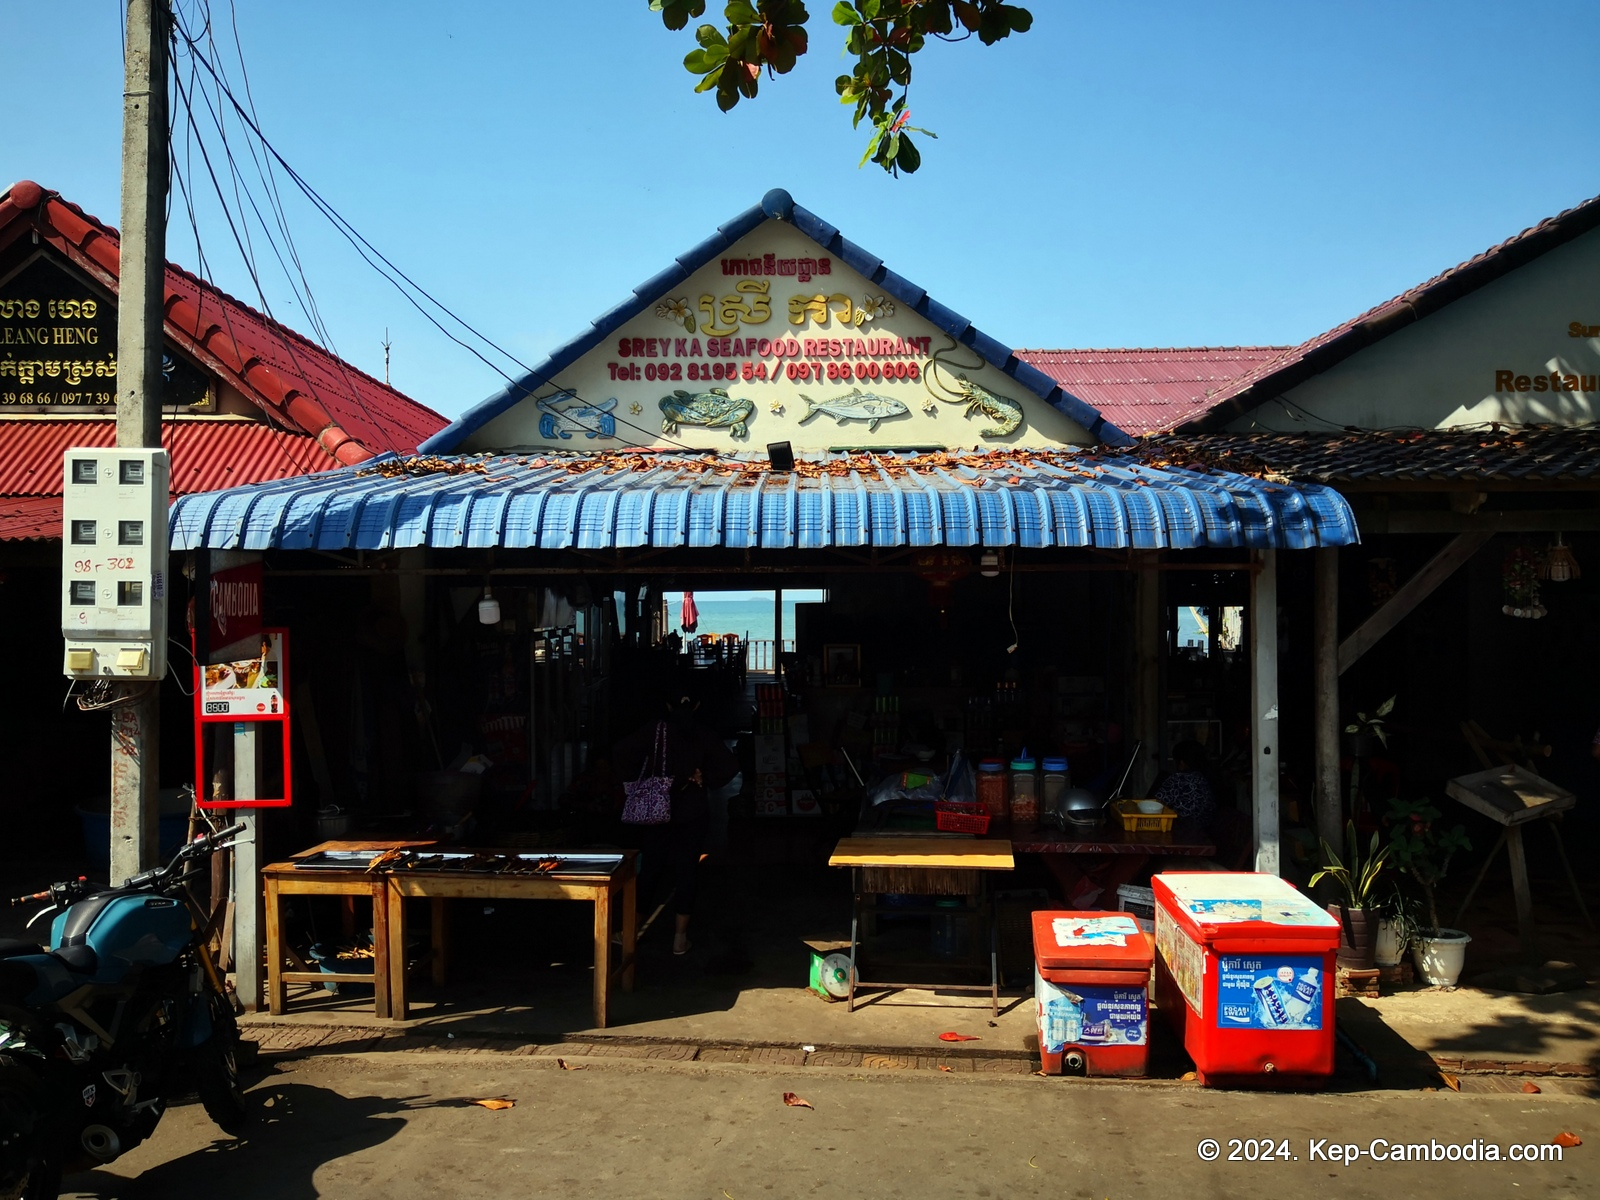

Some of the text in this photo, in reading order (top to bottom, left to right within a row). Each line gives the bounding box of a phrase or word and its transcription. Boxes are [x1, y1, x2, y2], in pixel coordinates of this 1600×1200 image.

[699, 279, 771, 337] ស្រី
[52, 327, 98, 345] HENG
[618, 337, 931, 357] SREY KA SEAFOOD RESTAURANT
[608, 360, 919, 381] Tel: 092 8195 54 / 097 86 00 606
[1495, 370, 1600, 392] Restau
[2, 392, 16, 404] 39
[20, 392, 34, 404] 68
[37, 392, 51, 404] 66
[61, 392, 82, 404] 097
[85, 392, 93, 404] 7
[95, 392, 110, 404] 39
[212, 580, 259, 619] CAMBODIA
